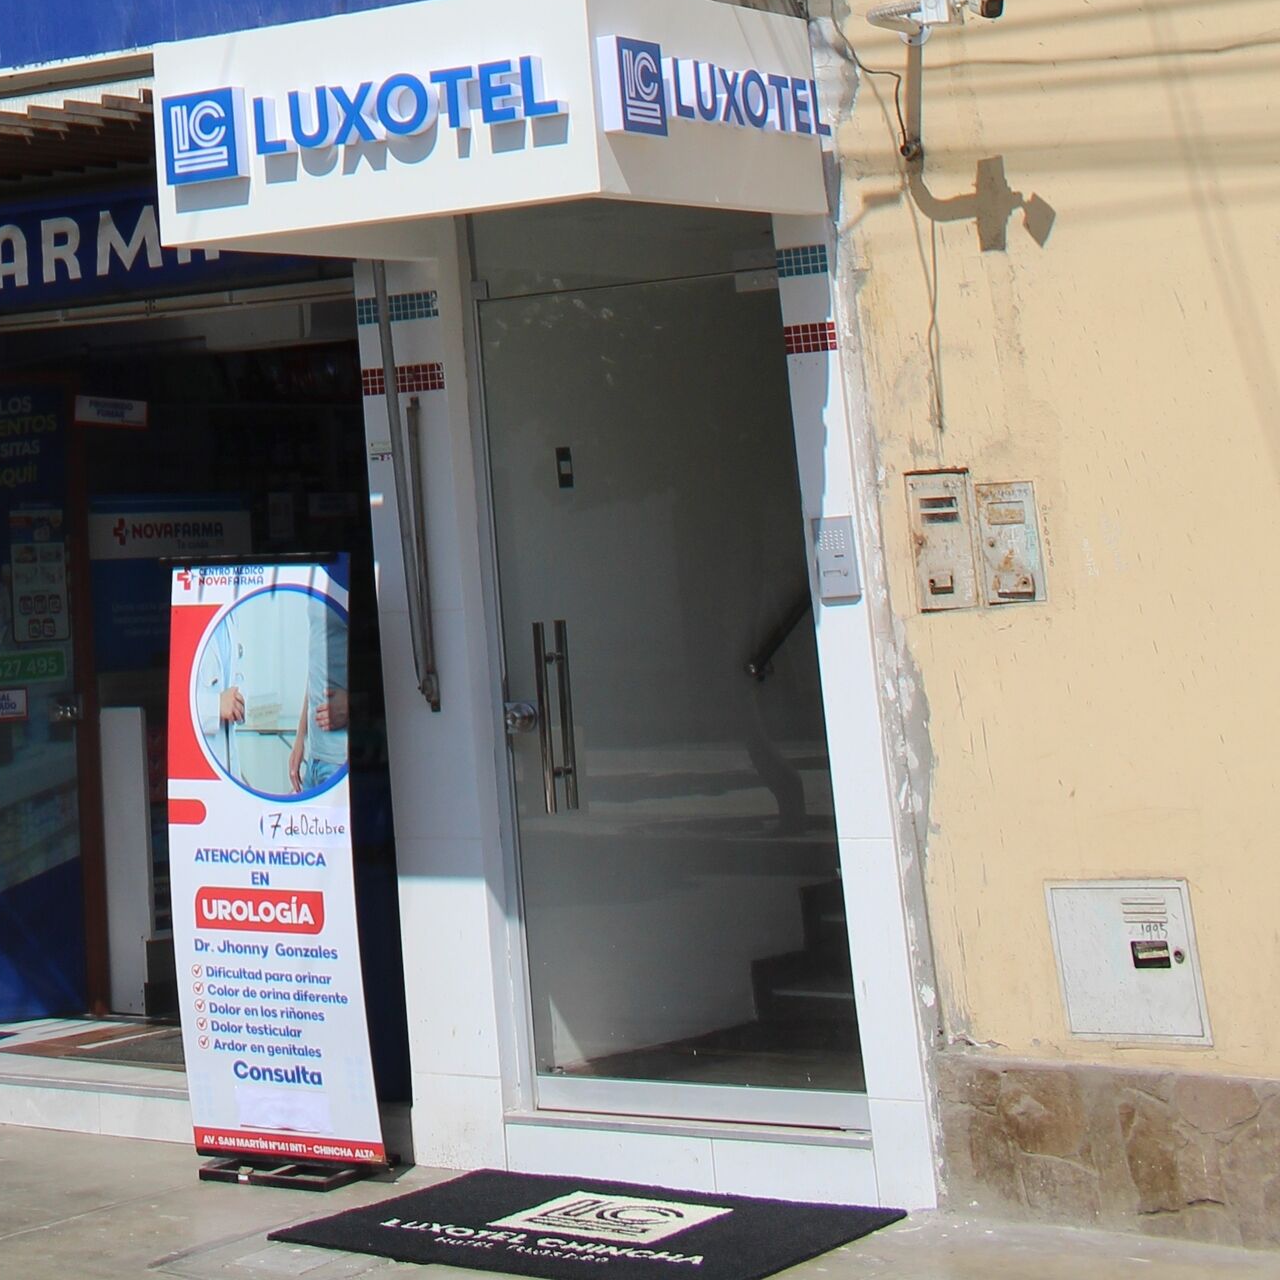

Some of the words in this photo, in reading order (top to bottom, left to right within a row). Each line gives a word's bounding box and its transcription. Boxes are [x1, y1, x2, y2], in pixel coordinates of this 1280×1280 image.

[253, 55, 558, 156] LUXOTEL
[671, 56, 832, 136] LUXOTEL
[131, 522, 224, 539] NOVAFARMA
[198, 566, 231, 576] CENTRO
[233, 565, 264, 575] MÉDICO
[198, 575, 264, 586] NOVAFARMA
[27, 656, 58, 674] 495
[260, 812, 282, 840] 17
[284, 813, 299, 836] de
[300, 813, 346, 836] Octubre
[194, 845, 266, 865] ATENCIÓN
[269, 846, 327, 867] MÉDICA
[251, 871, 269, 886] EN
[201, 896, 315, 925] UROLOGÍA
[194, 938, 215, 953] Dr.
[217, 939, 269, 959] Jhonny
[275, 942, 339, 960] Gonzales
[206, 965, 262, 981] Dificultad
[265, 972, 293, 984] para
[295, 973, 332, 986] orinar
[207, 983, 240, 998] Color
[242, 986, 257, 999] de
[259, 988, 290, 1001] orina
[292, 989, 349, 1005] diferente
[209, 1002, 241, 1016] Dolor
[244, 1007, 258, 1017] en
[260, 1005, 278, 1018] los
[280, 1006, 325, 1022] riñones
[210, 1020, 243, 1034] Dolor
[245, 1022, 303, 1038] testicular
[213, 1038, 247, 1053] Ardor
[250, 1043, 264, 1054] en
[267, 1043, 322, 1059] genitales
[233, 1059, 323, 1086] Consulta
[203, 1135, 218, 1145] AV.
[218, 1136, 236, 1147] SAN
[236, 1137, 269, 1150] MARTÍN
[313, 1145, 354, 1157] CHINCHA
[354, 1149, 376, 1160] ALTA
[380, 1218, 527, 1243] LUXOTEL
[536, 1237, 704, 1265] CHINCHA
